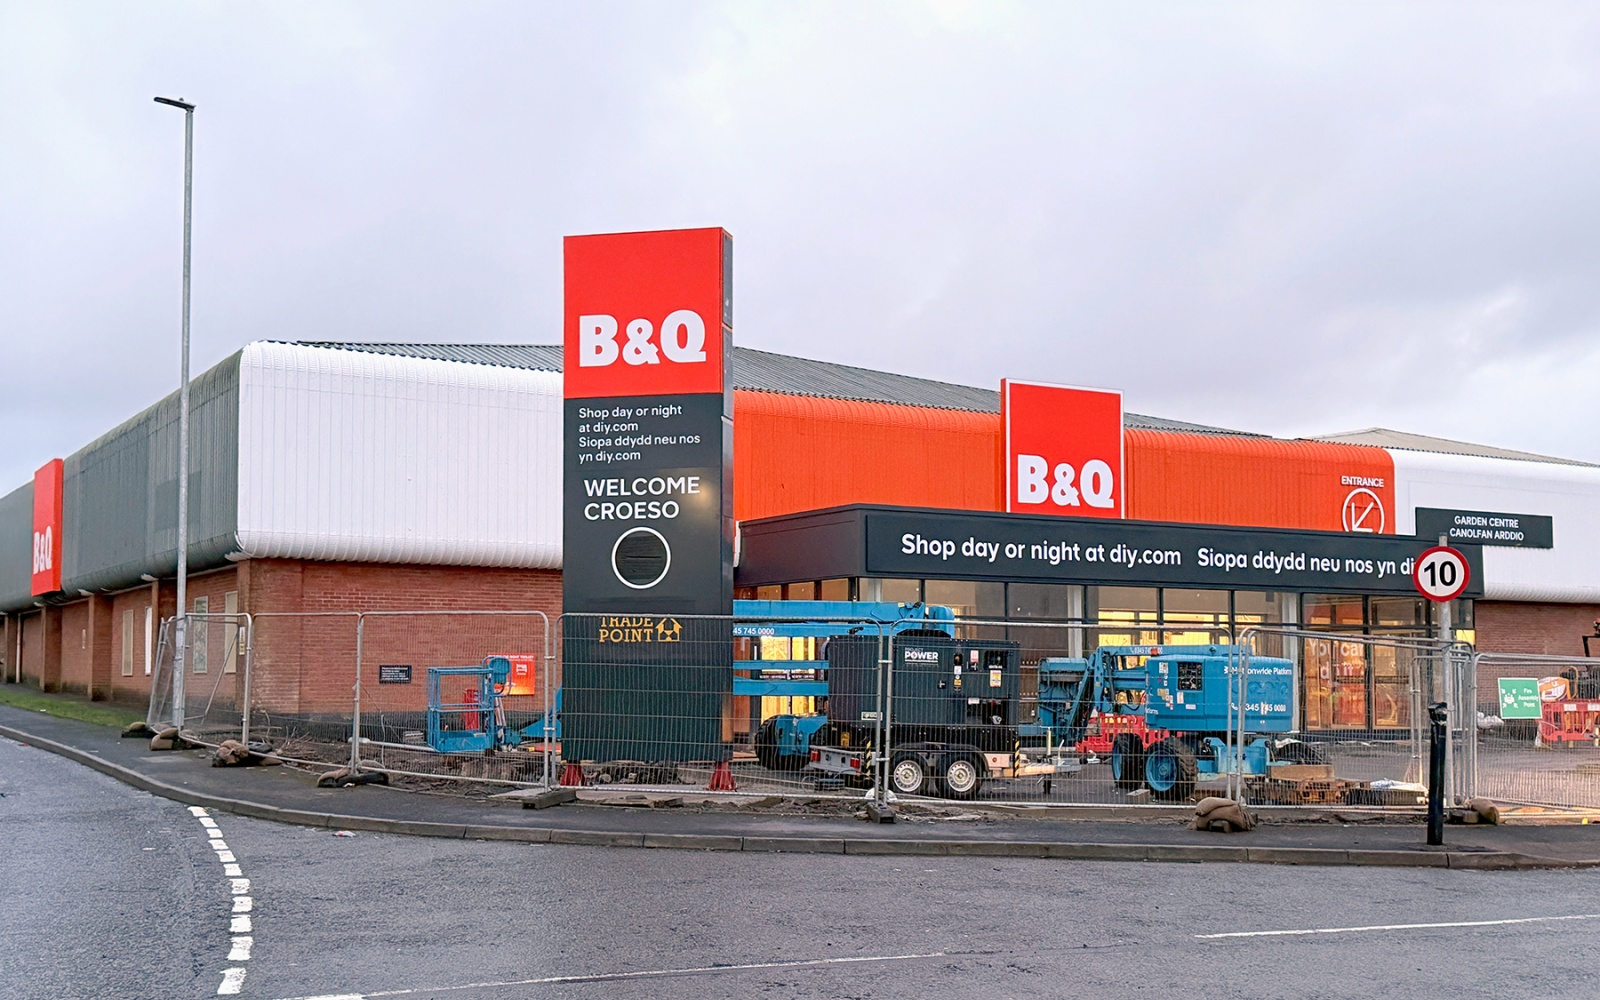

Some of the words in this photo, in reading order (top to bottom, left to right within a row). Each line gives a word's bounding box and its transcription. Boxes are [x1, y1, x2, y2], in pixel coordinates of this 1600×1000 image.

[578, 309, 707, 368] B&Q
[578, 407, 609, 420] Shop
[612, 407, 633, 419] day
[635, 408, 649, 417] or
[651, 405, 682, 418] night
[578, 424, 590, 433] at
[593, 422, 639, 434] diy.com
[578, 437, 612, 449] Siopa
[614, 435, 652, 448] ddydd
[654, 436, 676, 445] neu
[679, 435, 701, 444] nos
[578, 453, 593, 464] yn
[595, 451, 641, 463] diy.com
[584, 476, 701, 497] WELCOME
[1017, 453, 1115, 509] B&Q
[1341, 475, 1385, 488] ENTRANCE
[584, 500, 680, 521] CROESO
[1454, 515, 1488, 527] GARDEN
[1488, 516, 1519, 529] CENTRE
[1449, 527, 1493, 540] CANOLFAN
[1493, 529, 1525, 541] ARDDIO
[33, 525, 53, 575] B&Q
[901, 533, 956, 560] Shop
[961, 537, 1000, 562] day
[1004, 542, 1026, 559] or
[1031, 540, 1080, 566] night
[1085, 545, 1106, 563] at
[1110, 543, 1182, 569] diy.com
[1197, 547, 1248, 572] Siopa
[1251, 550, 1306, 574] ddydd
[1310, 556, 1341, 573] neu
[1345, 558, 1374, 574] nos
[1376, 561, 1396, 579] yn
[1423, 560, 1457, 588] 10
[601, 616, 654, 628] TRADE
[599, 629, 654, 643] POINT
[743, 627, 757, 636] 745
[757, 628, 775, 636] 0000
[904, 651, 939, 661] POWER
